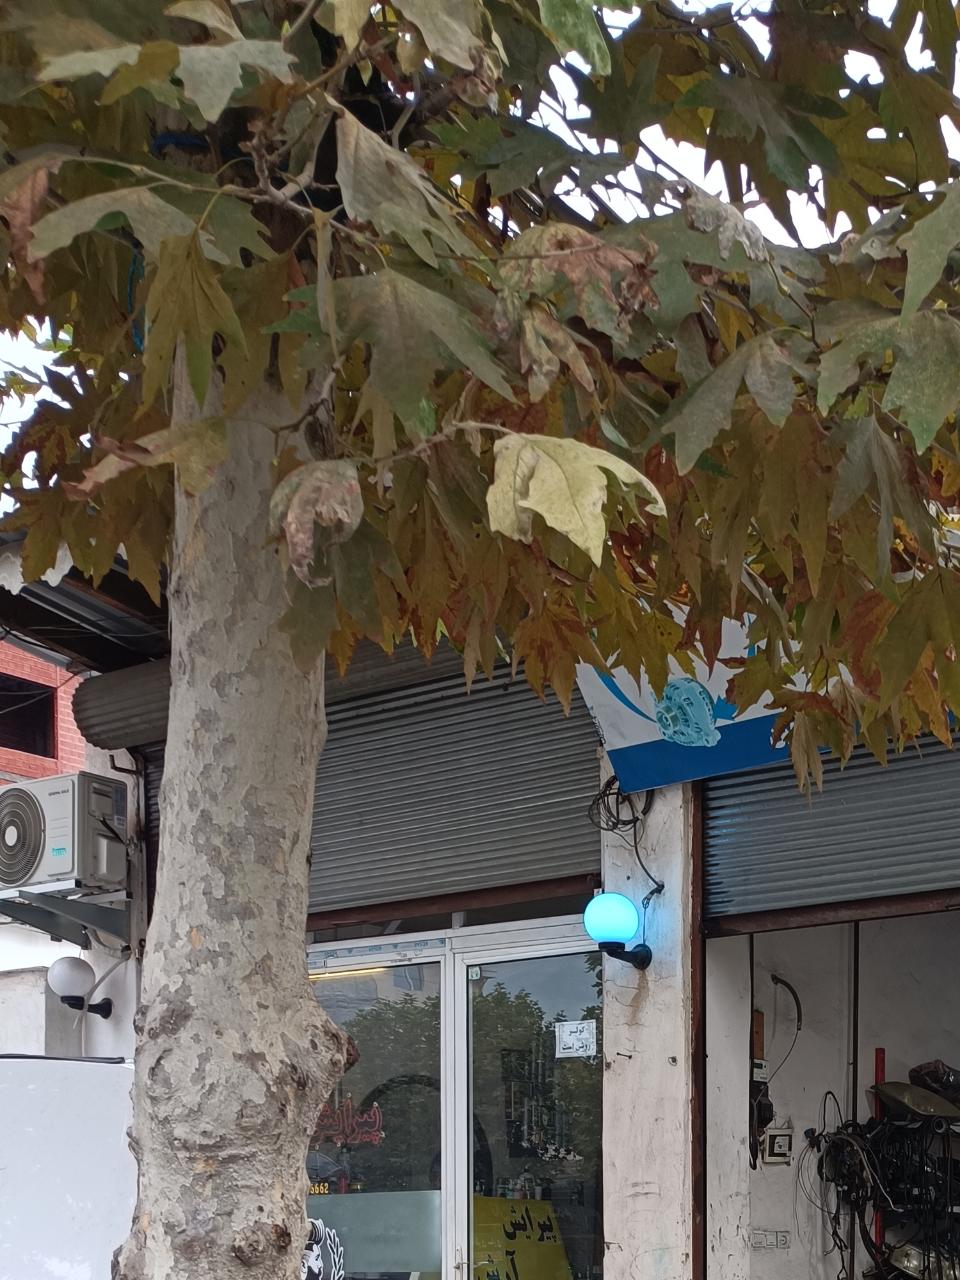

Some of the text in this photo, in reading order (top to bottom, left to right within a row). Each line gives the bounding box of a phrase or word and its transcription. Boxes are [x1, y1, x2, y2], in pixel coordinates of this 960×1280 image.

[568, 1025, 585, 1036] کولر
[561, 1042, 575, 1051] است
[502, 1204, 558, 1243] پیرایش
